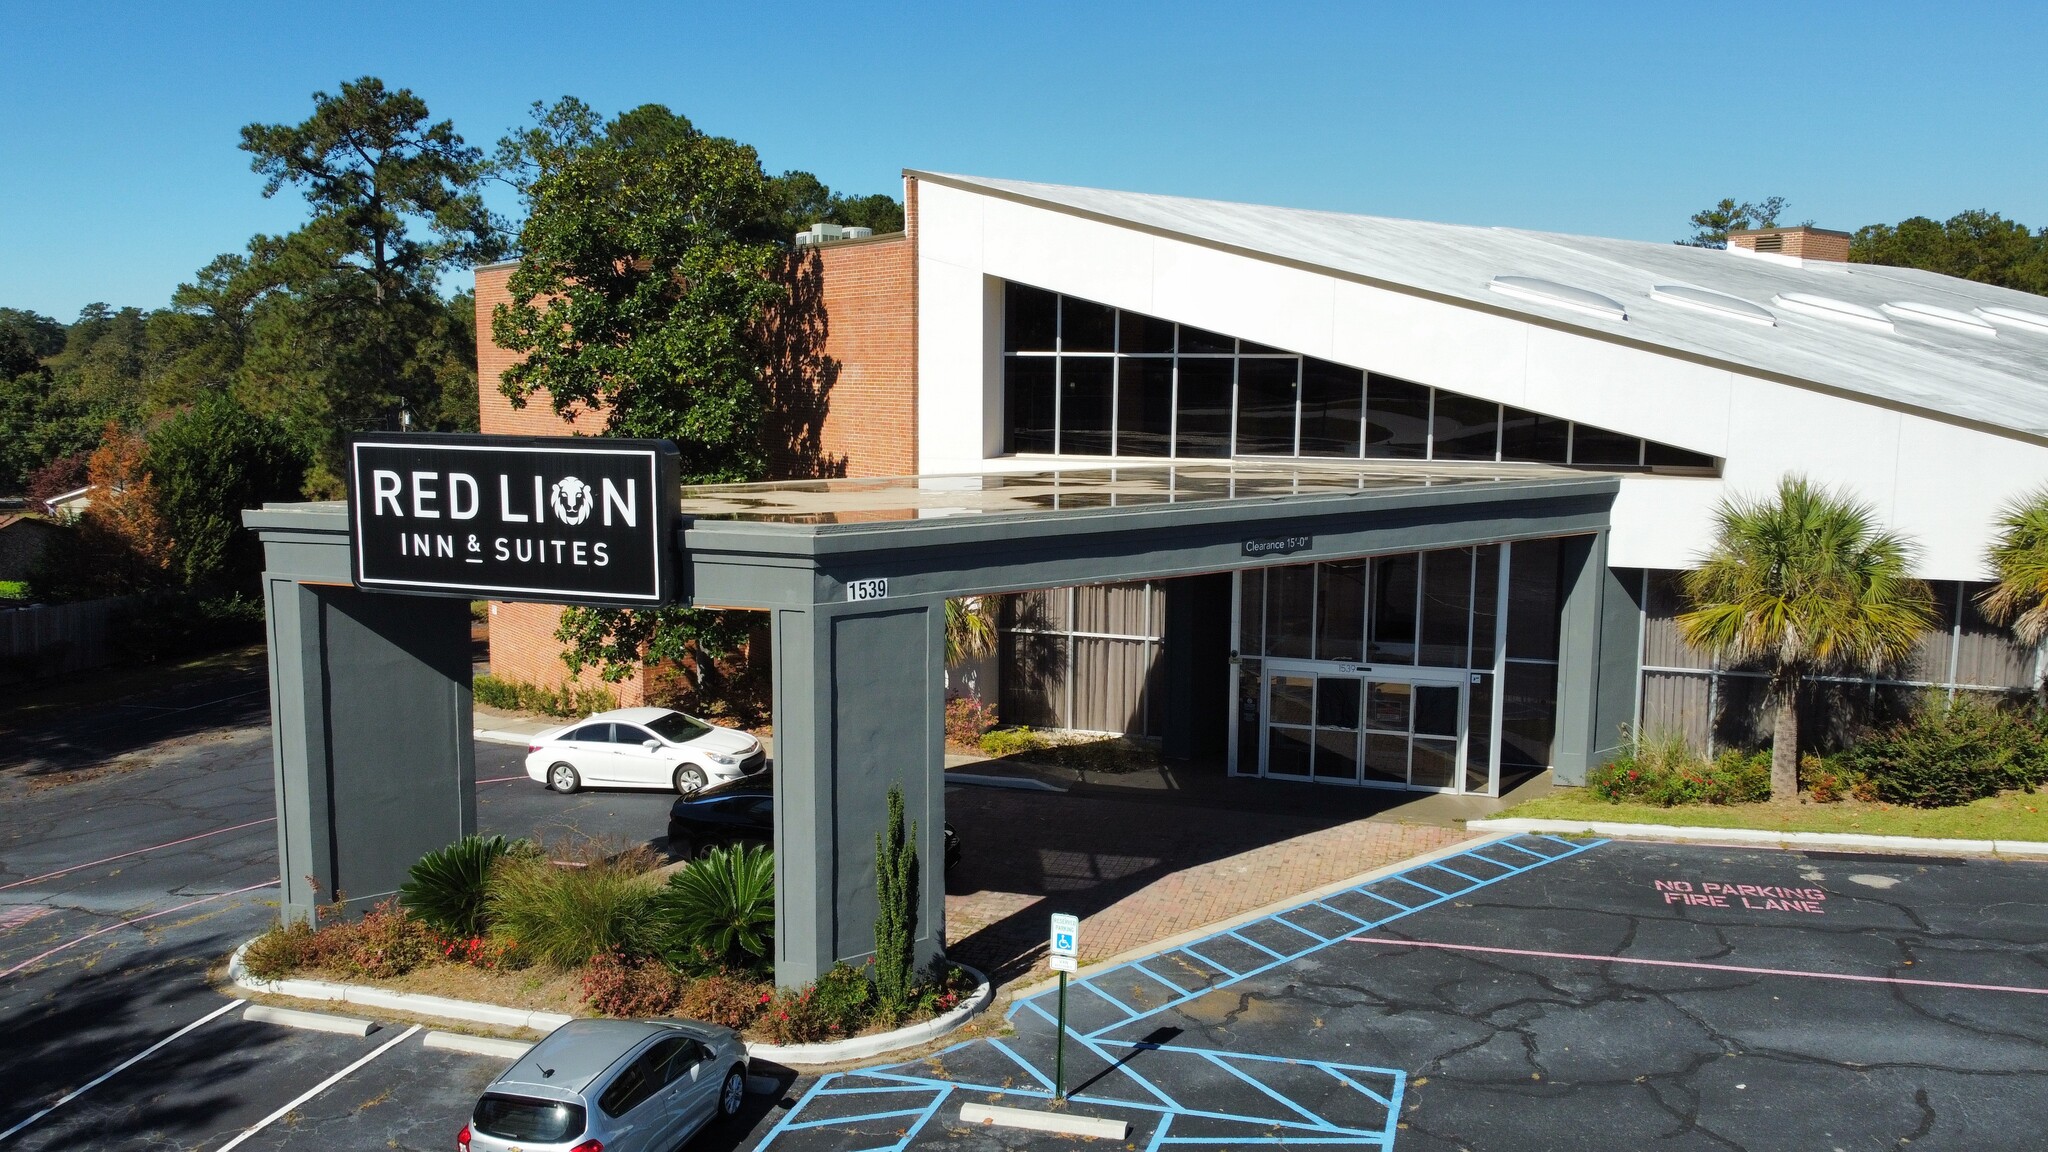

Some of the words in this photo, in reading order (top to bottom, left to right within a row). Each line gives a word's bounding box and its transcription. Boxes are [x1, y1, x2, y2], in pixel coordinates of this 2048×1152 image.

[374, 470, 478, 519] RED
[500, 475, 636, 527] LION
[402, 533, 453, 557] INN
[495, 538, 608, 566] SUITES
[1246, 541, 1285, 552] Clearance
[849, 580, 886, 600] 1539
[1338, 664, 1356, 673] 1539
[1654, 880, 1693, 892] NO
[1702, 882, 1826, 901] PARKING
[1664, 892, 1730, 908] FIRE
[1741, 897, 1825, 914] LANE
